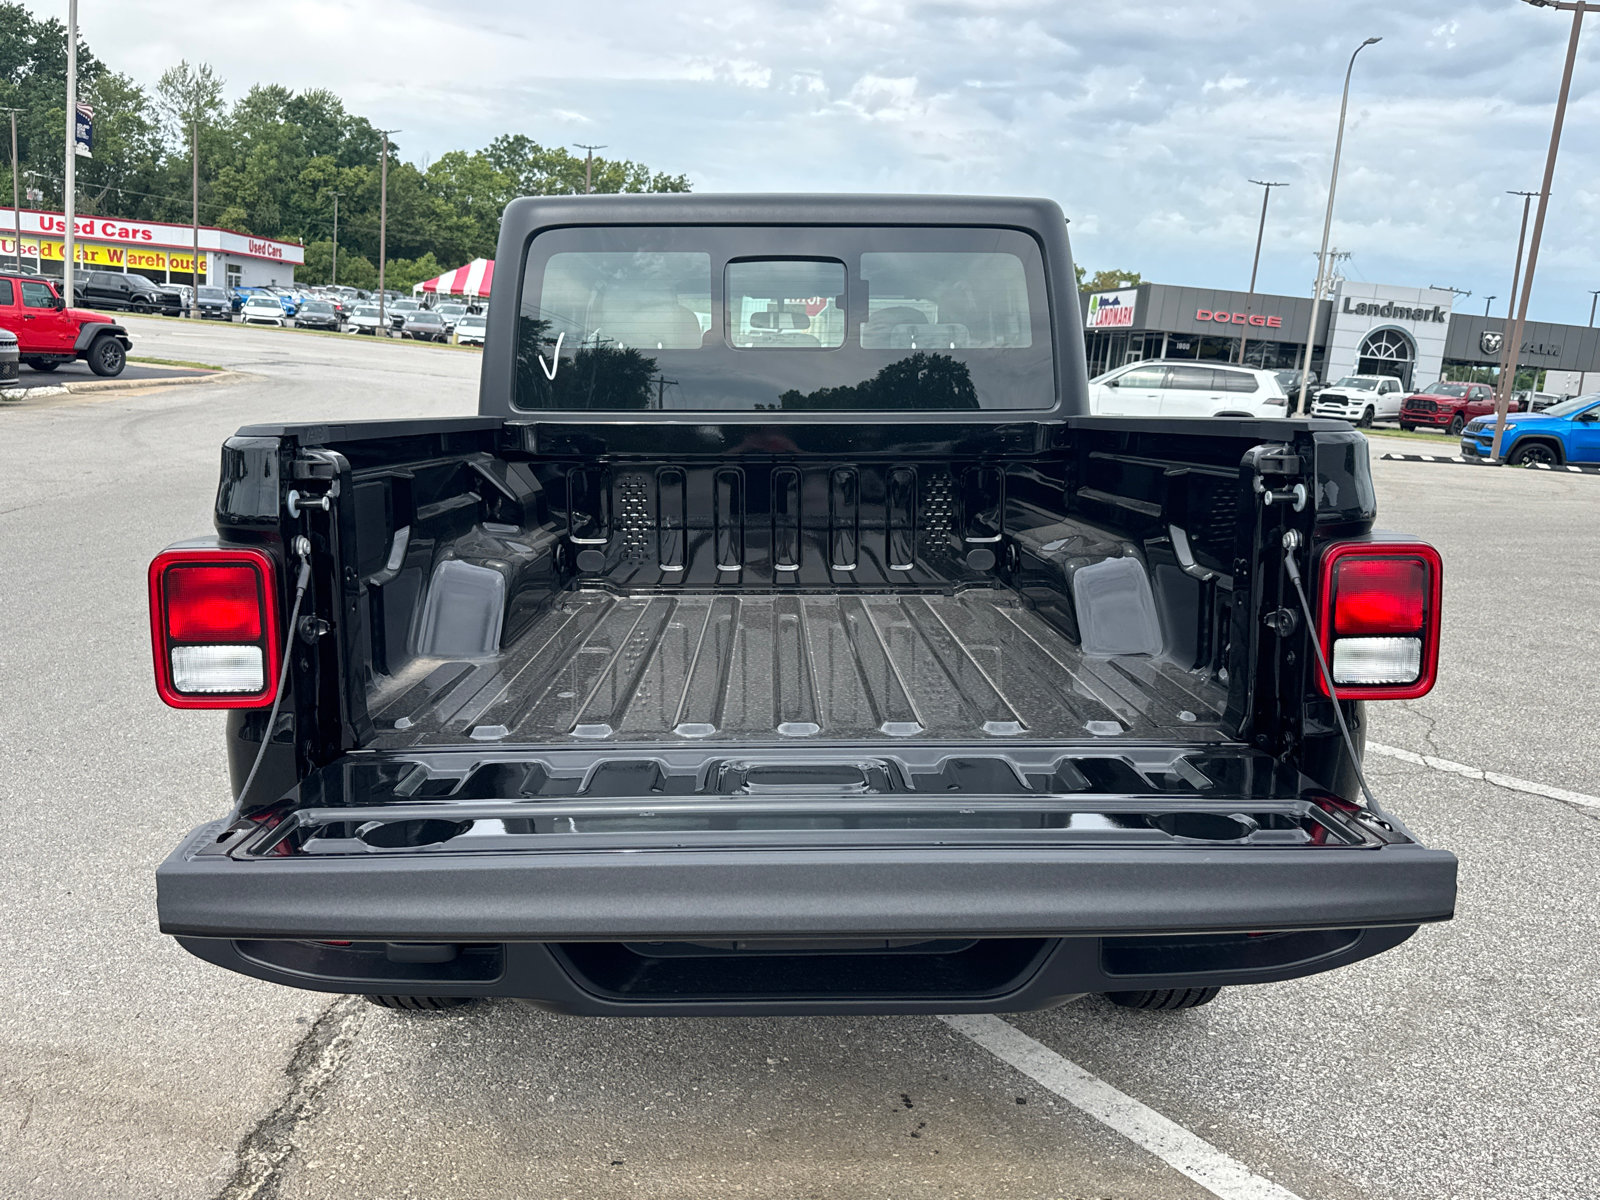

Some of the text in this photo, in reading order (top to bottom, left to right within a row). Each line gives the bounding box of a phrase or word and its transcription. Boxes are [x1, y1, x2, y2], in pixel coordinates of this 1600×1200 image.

[39, 216, 153, 241] Used Cars
[1, 240, 53, 257] Used
[248, 239, 283, 258] Used Cars
[1095, 306, 1134, 326] LANDMARK
[1196, 308, 1283, 328] DODGE
[1343, 297, 1447, 323] Landmark
